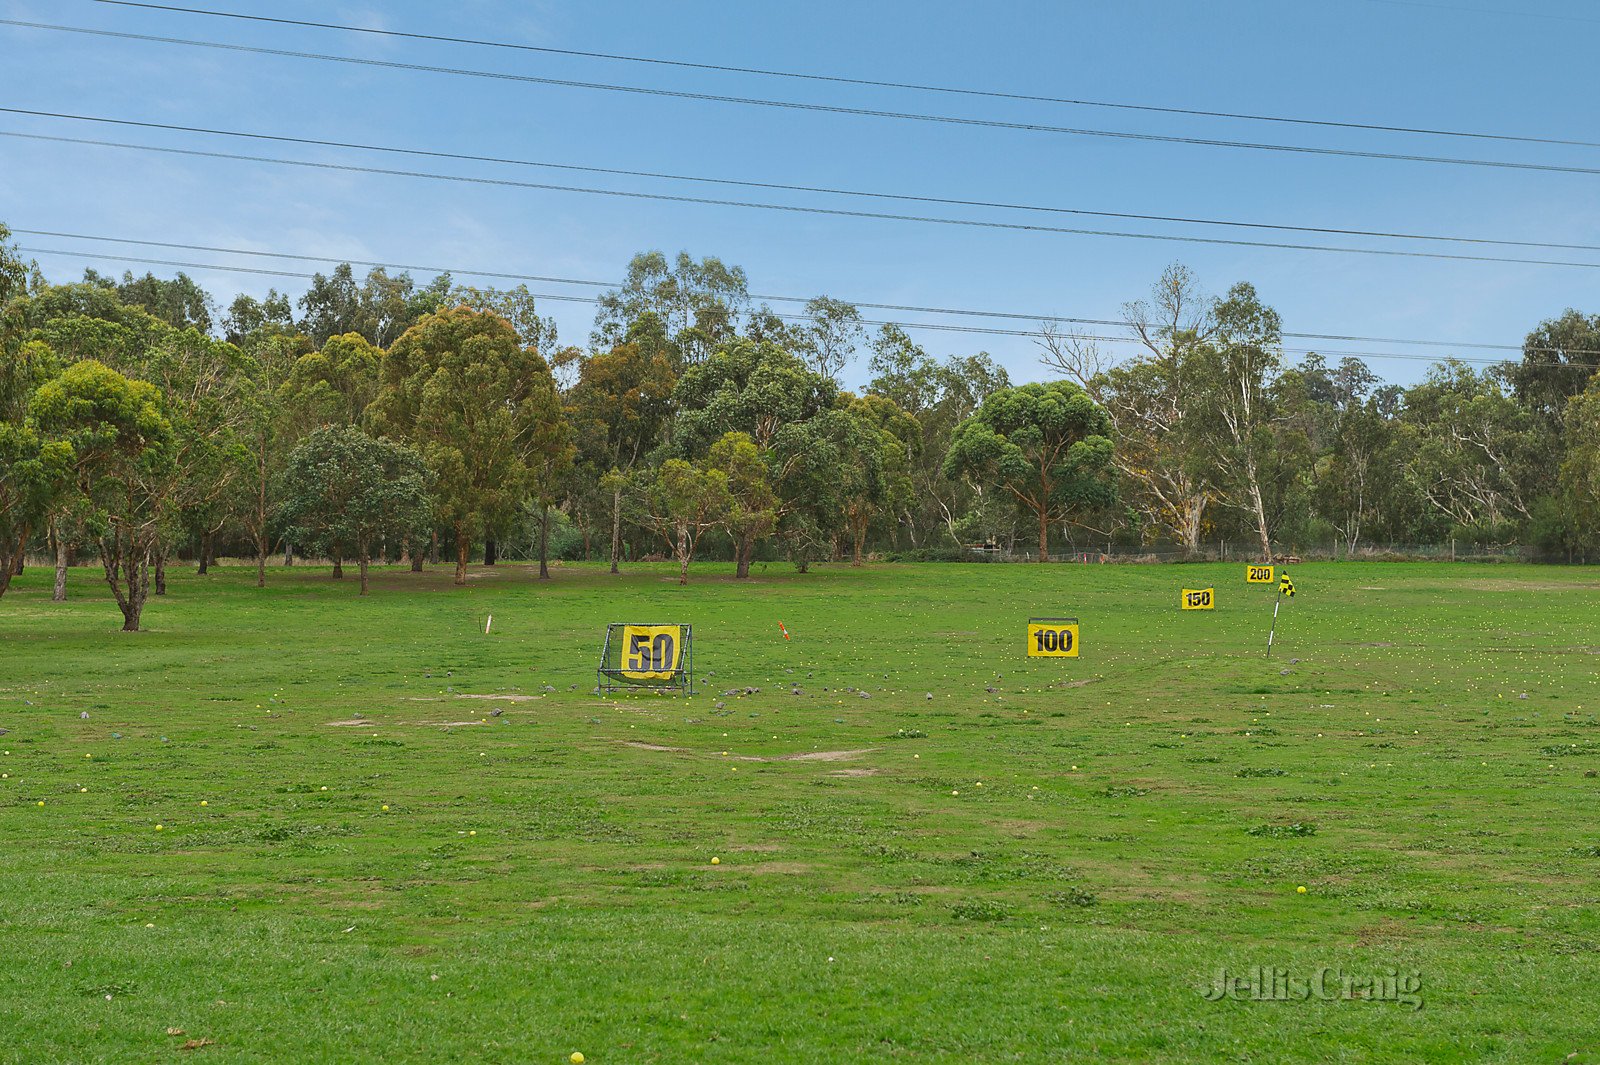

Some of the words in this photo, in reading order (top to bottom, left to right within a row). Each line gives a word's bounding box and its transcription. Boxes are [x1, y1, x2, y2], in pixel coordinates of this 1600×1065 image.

[1250, 568, 1270, 580] 200
[1186, 591, 1210, 606] 150
[1034, 629, 1073, 652] 100
[628, 633, 674, 673] 50
